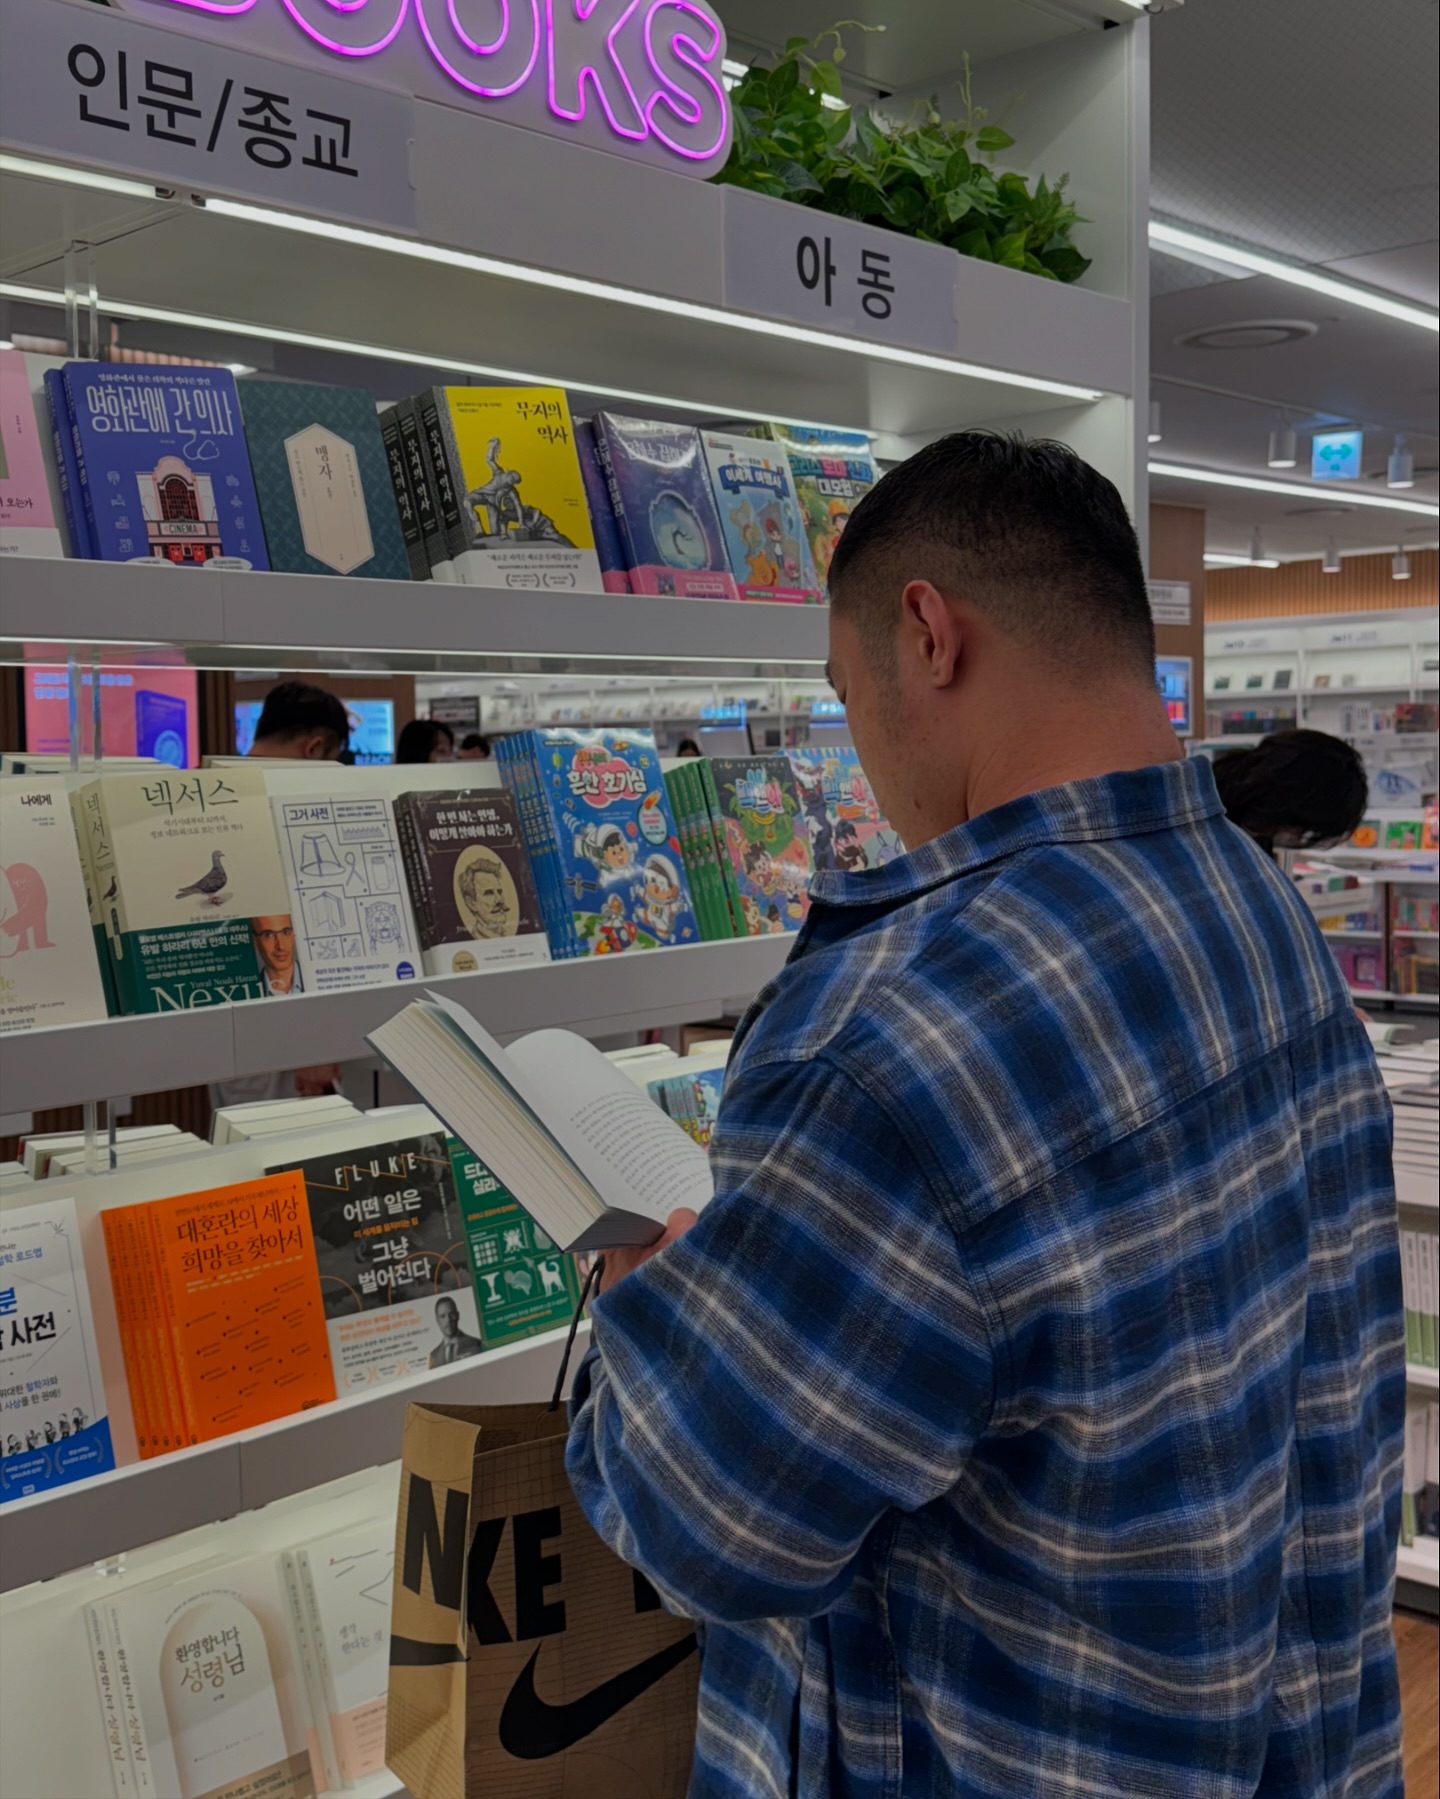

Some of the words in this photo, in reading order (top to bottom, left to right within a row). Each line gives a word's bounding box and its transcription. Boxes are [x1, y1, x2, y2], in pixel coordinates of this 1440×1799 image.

[67, 43, 359, 177] 인문/종교
[86, 384, 170, 433] 영화관에
[169, 387, 196, 434] 간
[192, 389, 235, 436] 의사
[516, 401, 562, 420] 무지의
[537, 425, 568, 445] 역사
[168, 524, 198, 534] CINEMA
[141, 777, 239, 815] 넥서스
[566, 769, 600, 795] 흔한
[600, 768, 648, 794] 호기심
[20, 794, 52, 806] 나에게
[289, 808, 309, 821] 그거
[310, 807, 330, 820] 사전
[87, 793, 111, 860] 넥서스
[429, 826, 458, 841] 어떻게
[486, 823, 513, 837] 하는가
[141, 943, 161, 956] 유발
[162, 940, 190, 953] 하라리
[191, 937, 208, 949] 6년
[209, 935, 228, 947] 만의
[229, 932, 250, 944] 신작!
[334, 1152, 417, 1186] FLUKE
[177, 1204, 258, 1244] 대혼란의
[262, 1195, 300, 1224] 세상
[343, 1196, 381, 1222] 어떤
[383, 1188, 422, 1215] 일은
[16, 1246, 43, 1262] 로드맵
[181, 1242, 245, 1274] 희망을
[246, 1224, 304, 1261] 찾아서
[372, 1235, 409, 1262] 그냥
[358, 1256, 431, 1294] 벌어진다
[11, 1311, 57, 1346] 사전
[4, 1397, 29, 1411] 사상을
[31, 1393, 40, 1402] 한
[175, 1625, 240, 1665] 환영합니다
[180, 1643, 245, 1694] 성령님
